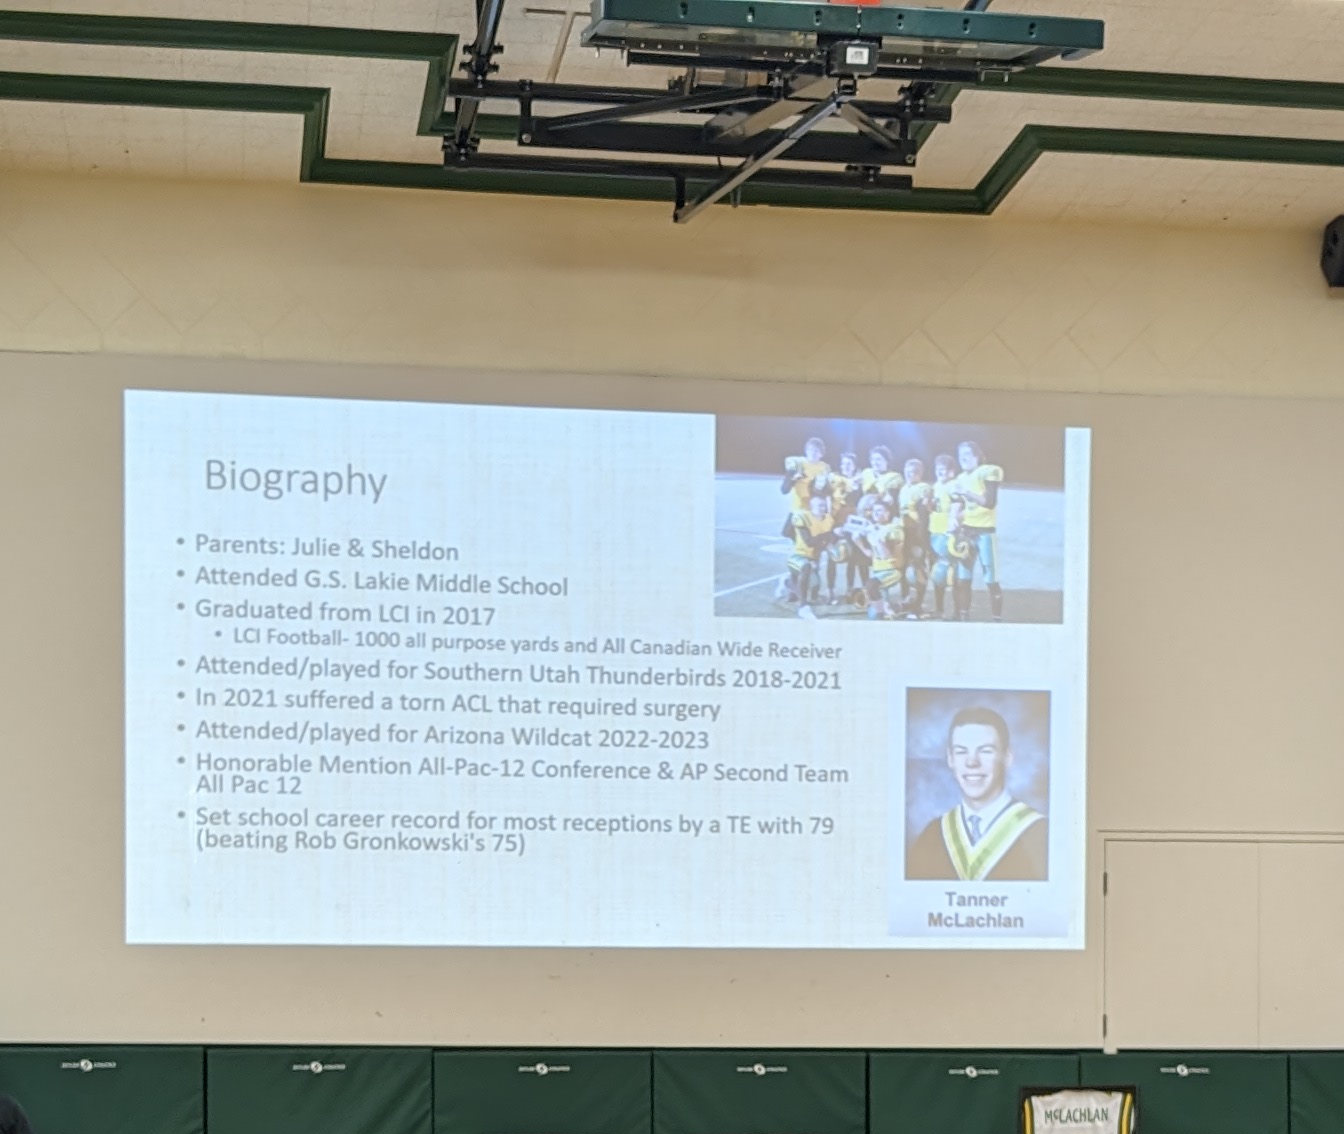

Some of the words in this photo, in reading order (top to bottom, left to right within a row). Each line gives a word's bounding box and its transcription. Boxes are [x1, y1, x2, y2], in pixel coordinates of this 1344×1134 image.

[205, 459, 388, 505] Biography
[195, 533, 286, 556] Parents:
[290, 537, 341, 557] Julie
[346, 537, 366, 558] &
[370, 539, 460, 562] Sheldon
[194, 565, 298, 588] Attended
[303, 569, 347, 589] G.S.
[354, 570, 411, 592] Lakie
[415, 572, 492, 594] Middle
[497, 575, 569, 596] School
[194, 598, 313, 621] Graduated
[318, 601, 372, 622] from
[378, 603, 410, 624] LCI
[416, 605, 436, 625] in
[442, 605, 496, 626] 2017
[233, 627, 261, 644] LCI
[266, 627, 350, 646] Football-
[354, 630, 402, 649] 1000
[404, 631, 427, 649] all
[431, 636, 507, 653] purpose
[510, 635, 560, 654] yards
[563, 636, 598, 654] and
[601, 637, 626, 655] All
[629, 638, 713, 656] Canadian
[716, 640, 764, 657] Wide
[767, 642, 843, 659] Receiver
[194, 655, 381, 683] Attended/played
[386, 659, 420, 680] for
[423, 661, 523, 683] Southern
[529, 664, 581, 684] Utah
[585, 665, 727, 688] Thunderbirds
[731, 669, 842, 690] 2018-2021
[195, 688, 217, 707] In
[222, 687, 278, 708] 2021
[283, 688, 375, 710] suffered
[380, 696, 394, 711] a
[398, 694, 446, 712] torn
[450, 693, 494, 714] ACL
[497, 694, 542, 715] that
[547, 697, 638, 720] required
[643, 702, 722, 723] surgery
[195, 721, 381, 746] Attended/played
[386, 722, 419, 744] for
[423, 724, 505, 745] Arizona
[510, 726, 593, 747] Wildcat
[597, 728, 710, 750] 2022-2023
[196, 752, 313, 773] Honorable
[318, 754, 412, 776] Mention
[417, 756, 526, 778] All-Pac-12
[530, 759, 652, 780] Conference
[656, 760, 675, 780] &
[679, 762, 709, 781] AP
[713, 762, 789, 782] Second
[793, 764, 849, 783] Team
[195, 772, 224, 794] All
[230, 772, 270, 794] Pac
[276, 773, 303, 795] 12
[195, 806, 232, 827] Set
[237, 806, 309, 827] school
[314, 812, 386, 828] career
[390, 810, 461, 830] record
[466, 809, 498, 830] for
[503, 814, 557, 831] most
[562, 814, 673, 836] receptions
[678, 813, 704, 838] by
[708, 819, 721, 834] a
[726, 815, 752, 834] TE
[756, 816, 804, 835] with
[808, 816, 835, 835] 79
[196, 827, 289, 853] (beating
[294, 827, 337, 850] Rob
[342, 828, 486, 852] Gronkowski's
[491, 829, 526, 857] 75)
[944, 891, 1009, 907] Tanner
[927, 912, 1025, 929] McLachlan
